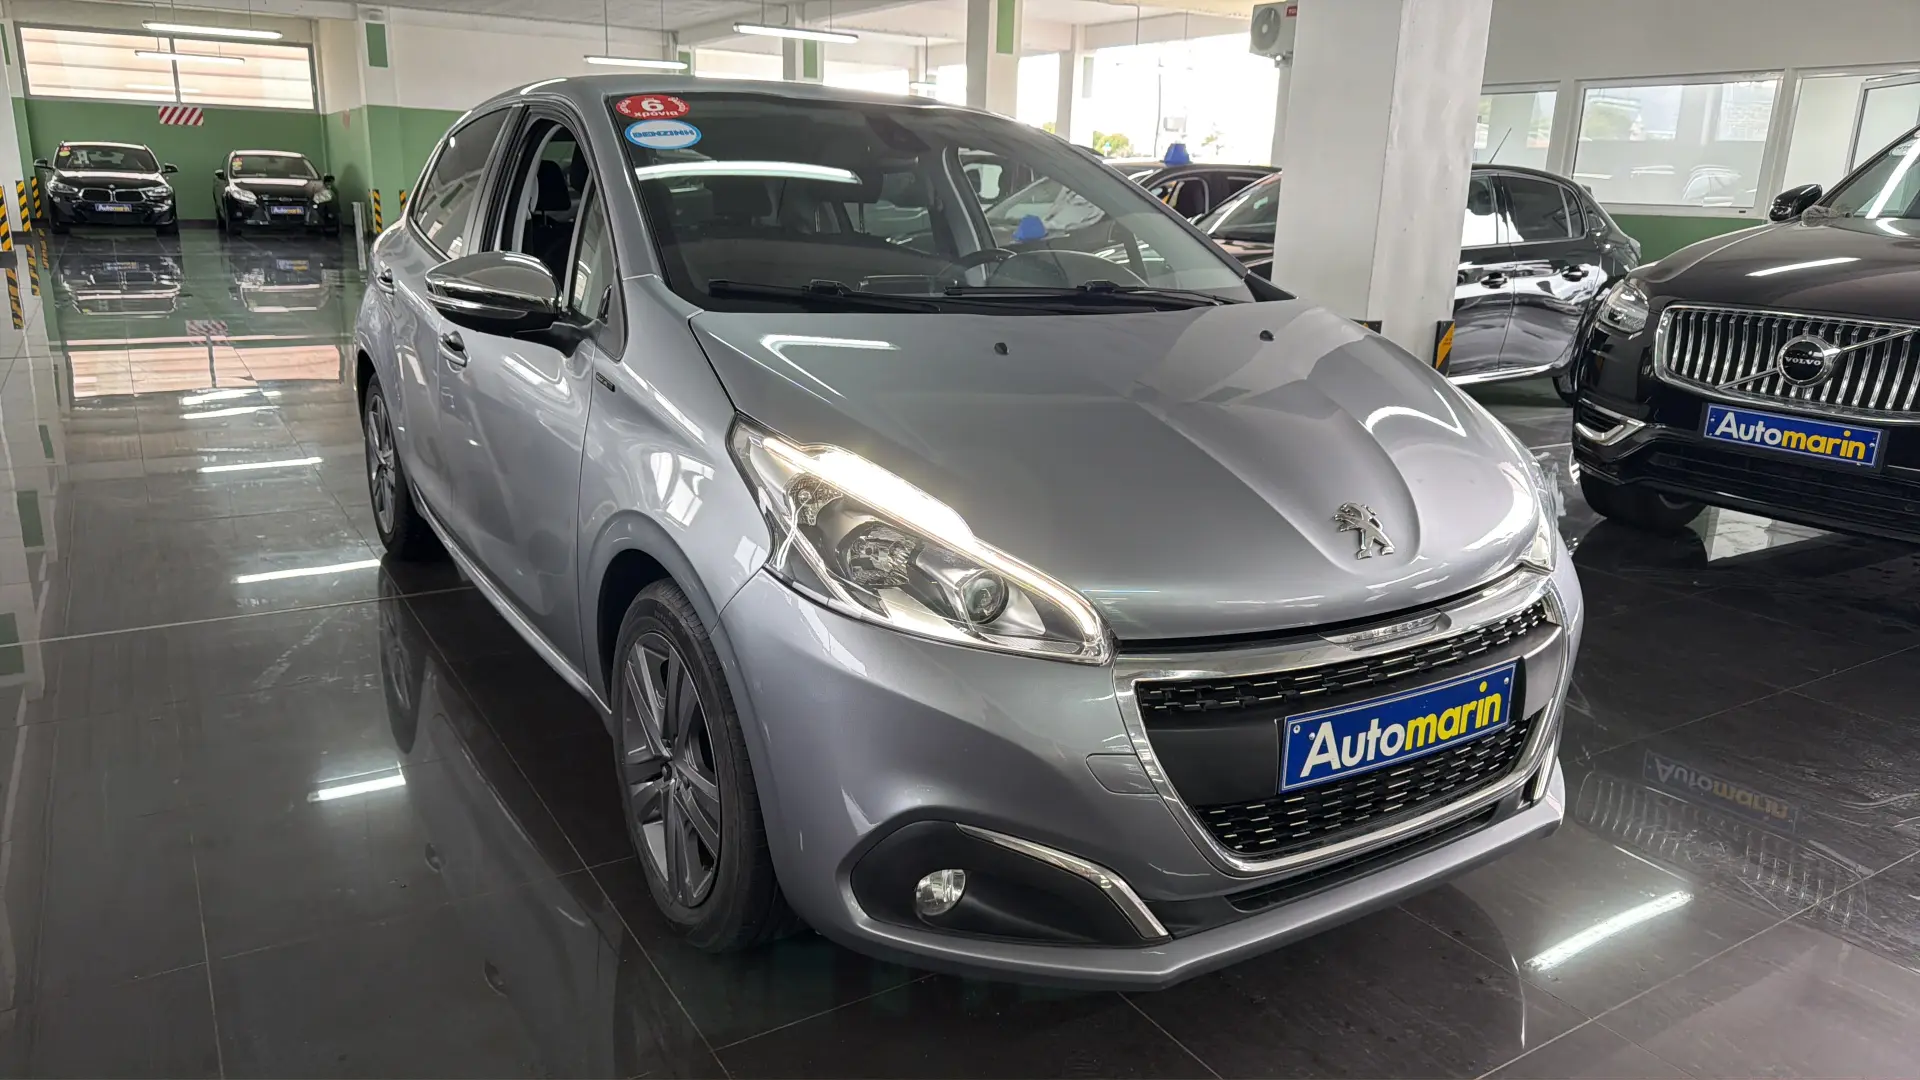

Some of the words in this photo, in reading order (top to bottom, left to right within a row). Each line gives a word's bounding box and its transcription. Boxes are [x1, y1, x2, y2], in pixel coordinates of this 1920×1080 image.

[640, 98, 665, 112] 6
[1784, 356, 1822, 367] VOLVO
[1714, 411, 1866, 460] Automarin
[1300, 681, 1502, 777] Automarin
